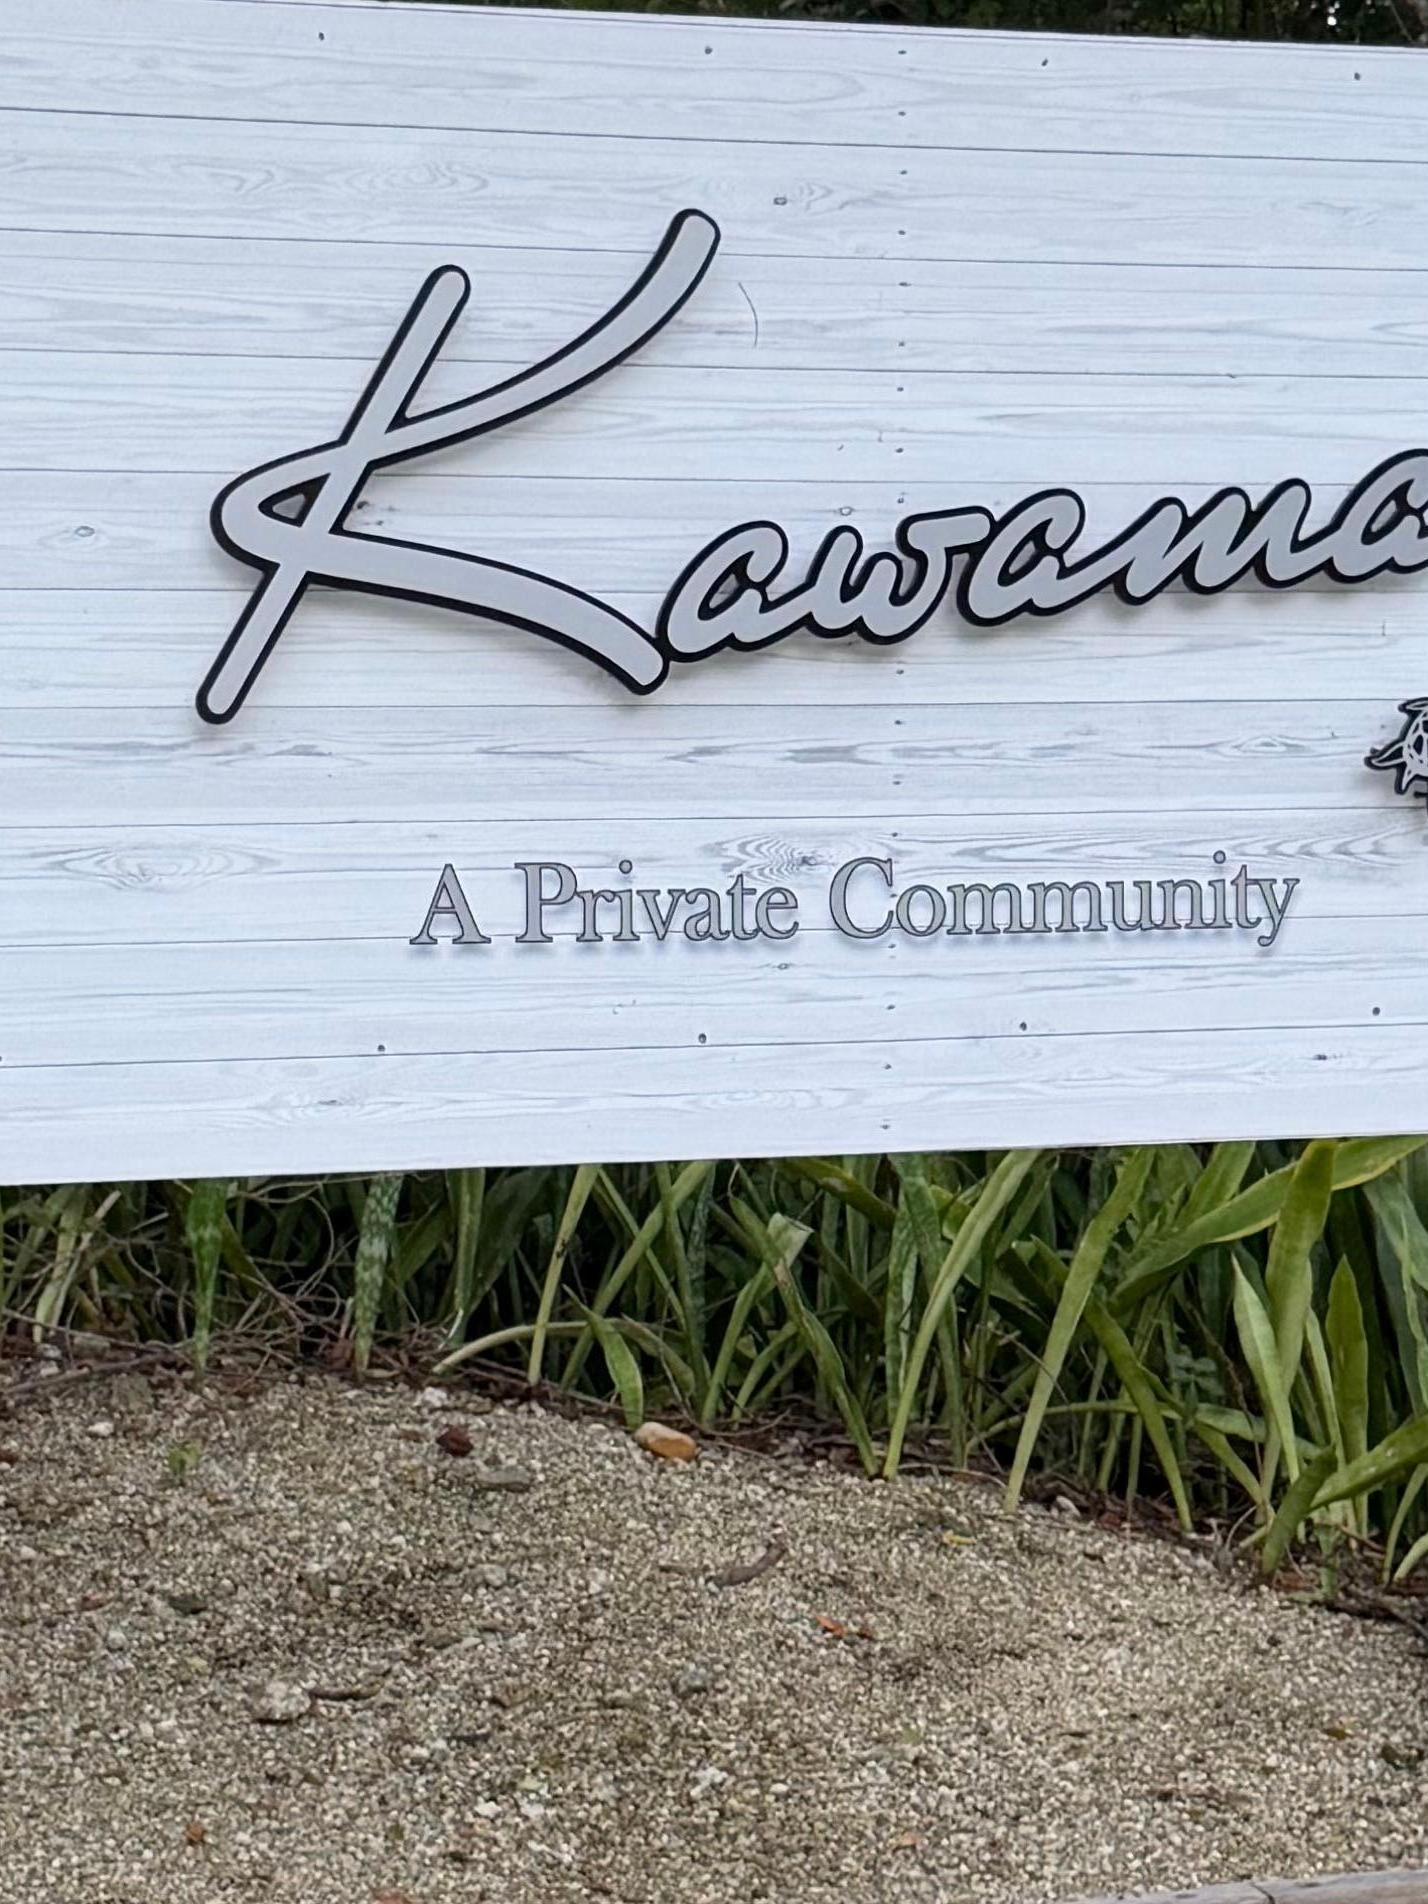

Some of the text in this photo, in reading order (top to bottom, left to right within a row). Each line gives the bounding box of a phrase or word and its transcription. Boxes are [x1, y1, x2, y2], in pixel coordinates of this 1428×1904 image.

[412, 850, 1299, 946] A Private Community
